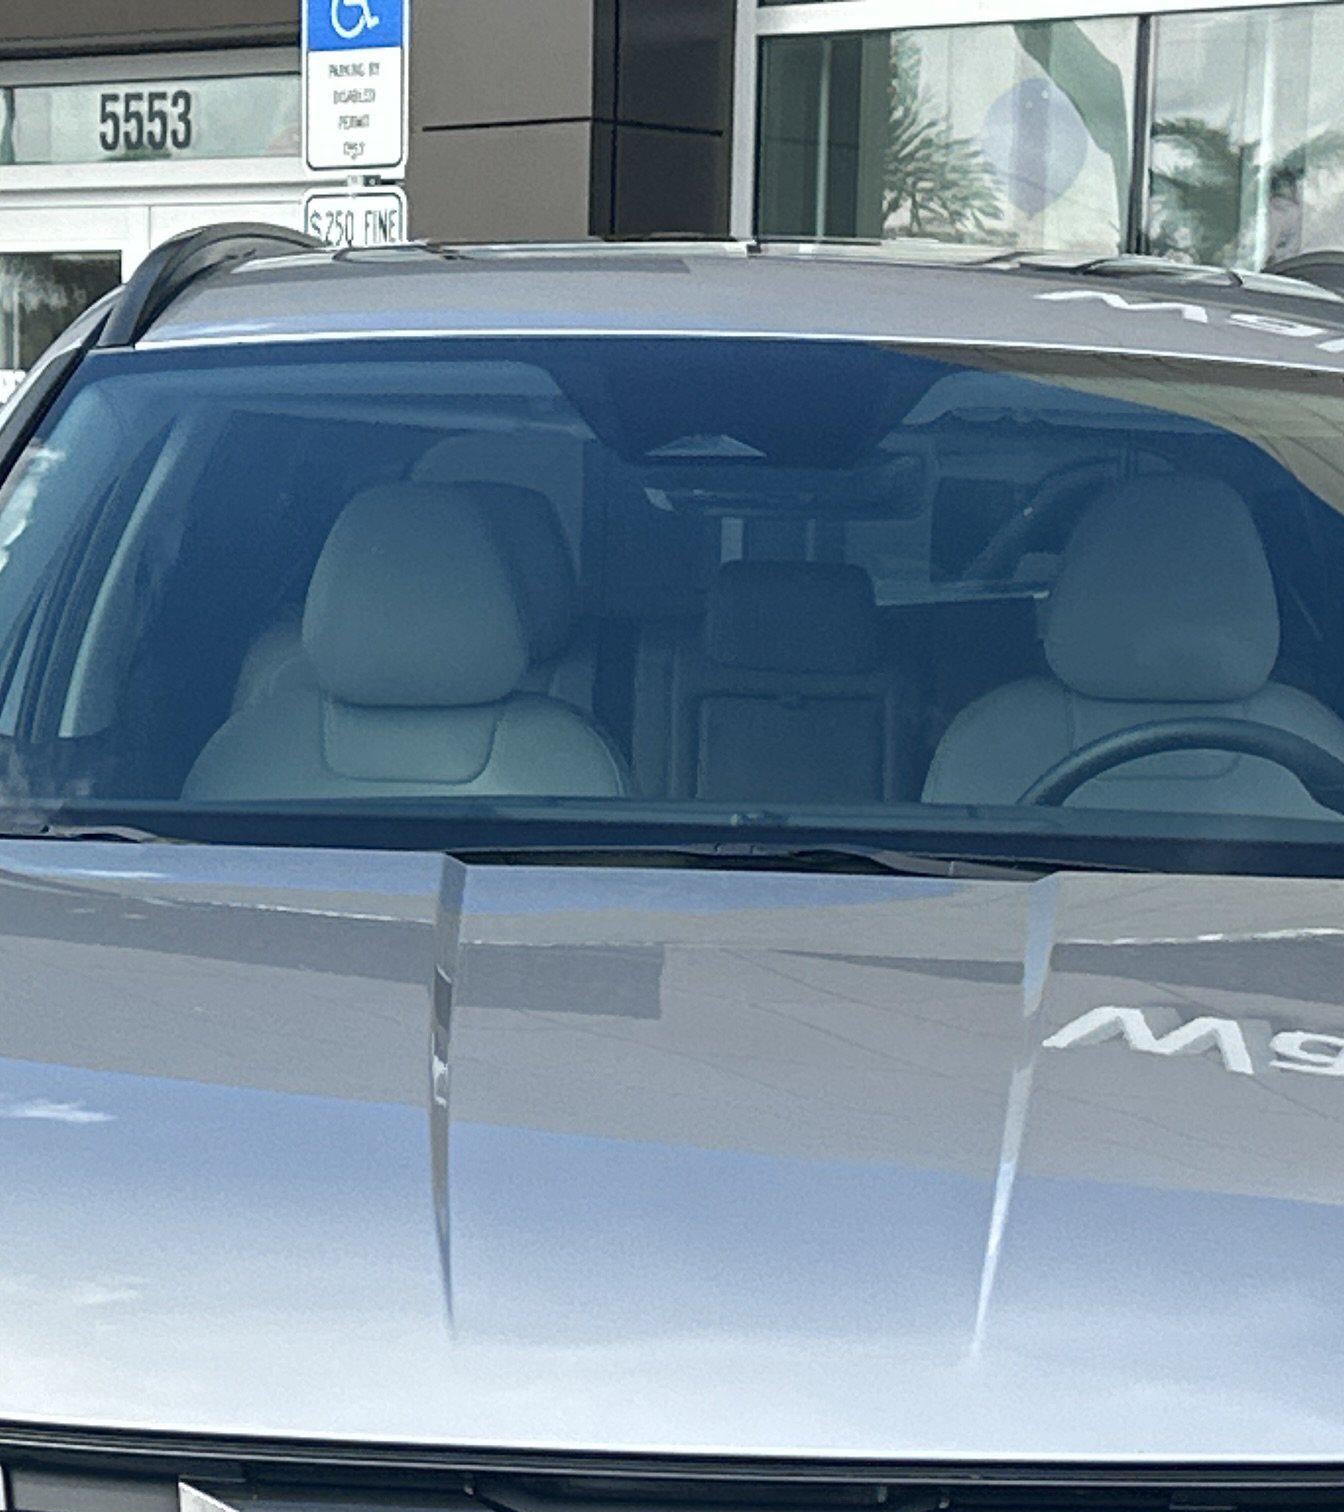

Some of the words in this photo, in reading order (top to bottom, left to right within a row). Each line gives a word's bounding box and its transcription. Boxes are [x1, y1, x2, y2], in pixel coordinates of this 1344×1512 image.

[99, 89, 192, 151] 5553
[309, 208, 355, 247] $250
[364, 208, 399, 246] FINE
